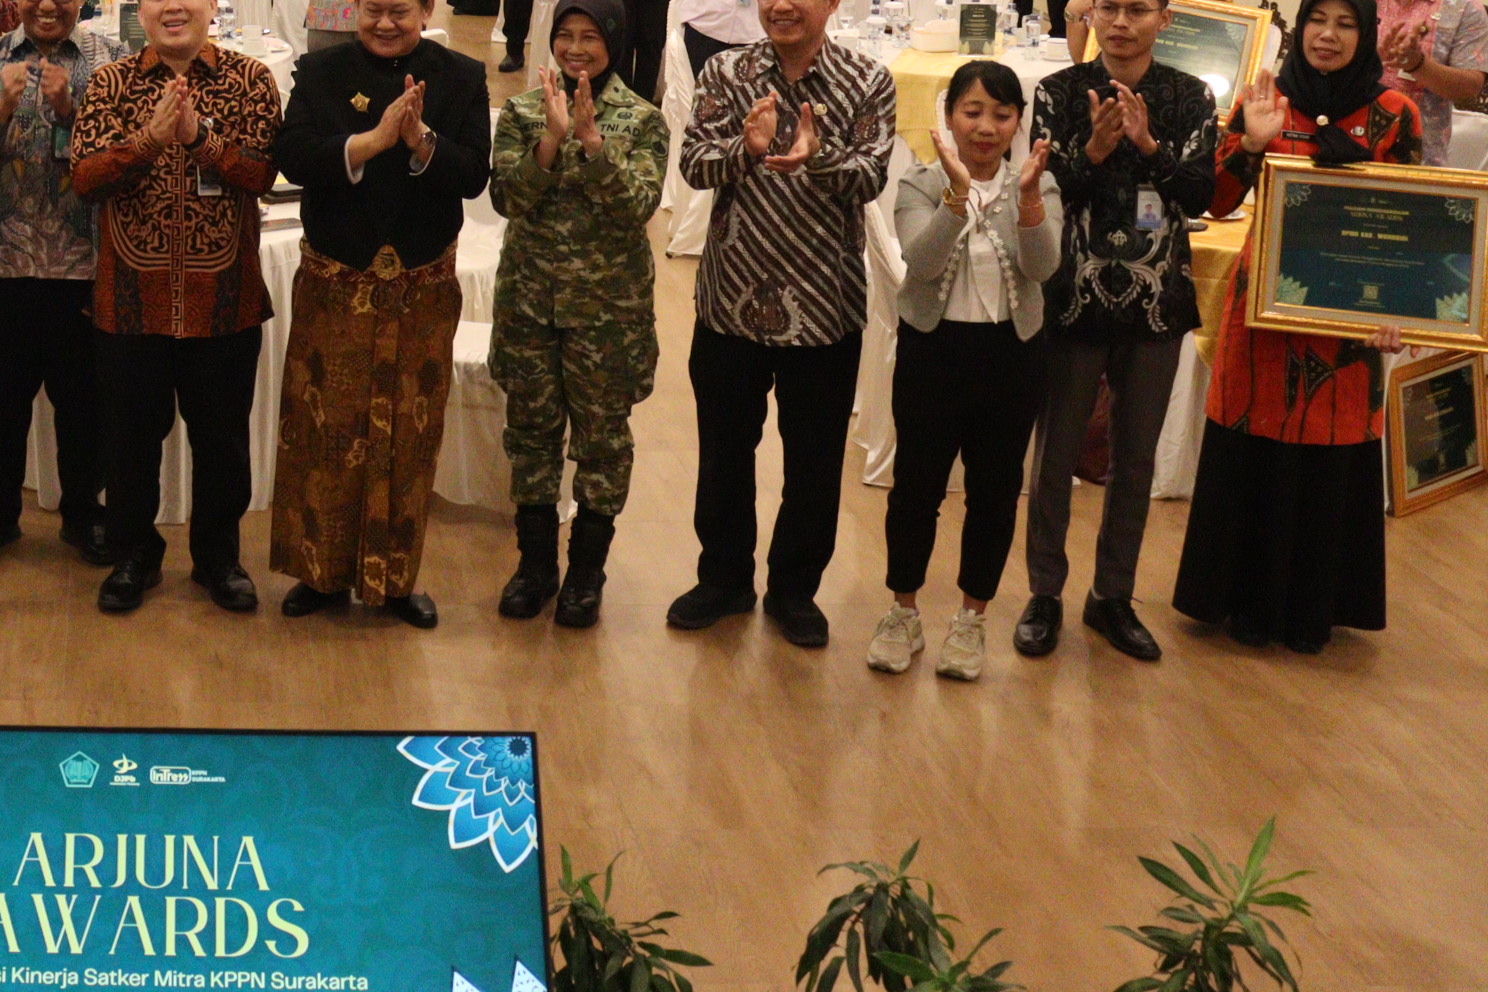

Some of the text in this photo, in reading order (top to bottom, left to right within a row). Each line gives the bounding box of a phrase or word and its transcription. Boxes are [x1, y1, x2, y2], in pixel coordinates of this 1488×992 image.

[600, 123, 641, 136] TNI AD
[12, 832, 270, 891] ARJUNA
[11, 966, 79, 989] Kinerja
[83, 968, 150, 987] Satker
[153, 969, 206, 988] Mitra
[210, 971, 266, 989] KPPN
[270, 972, 369, 991] Surakarta
